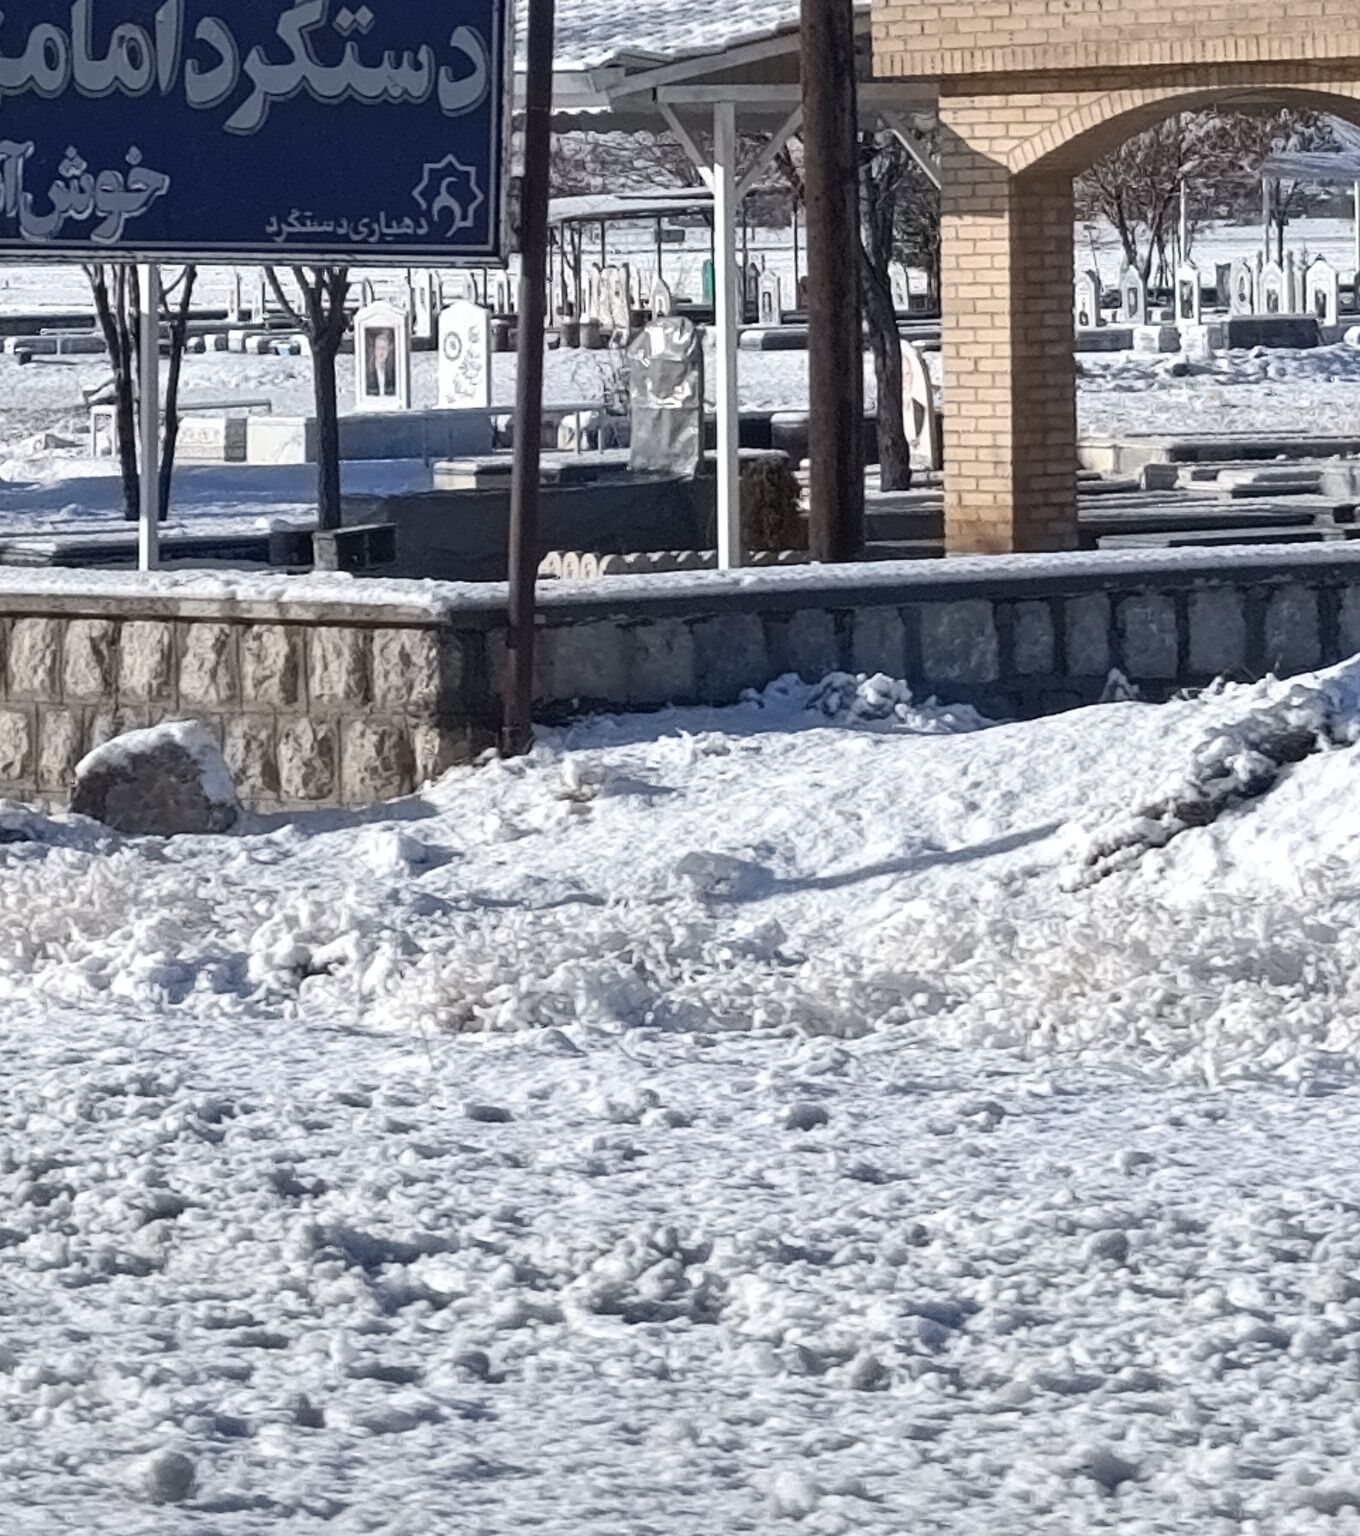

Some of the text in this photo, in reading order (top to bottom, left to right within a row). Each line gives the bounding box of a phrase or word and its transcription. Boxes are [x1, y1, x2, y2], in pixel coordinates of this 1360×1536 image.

[19, 145, 170, 244] خوش
[265, 208, 429, 243] دهیاری دستگرد
